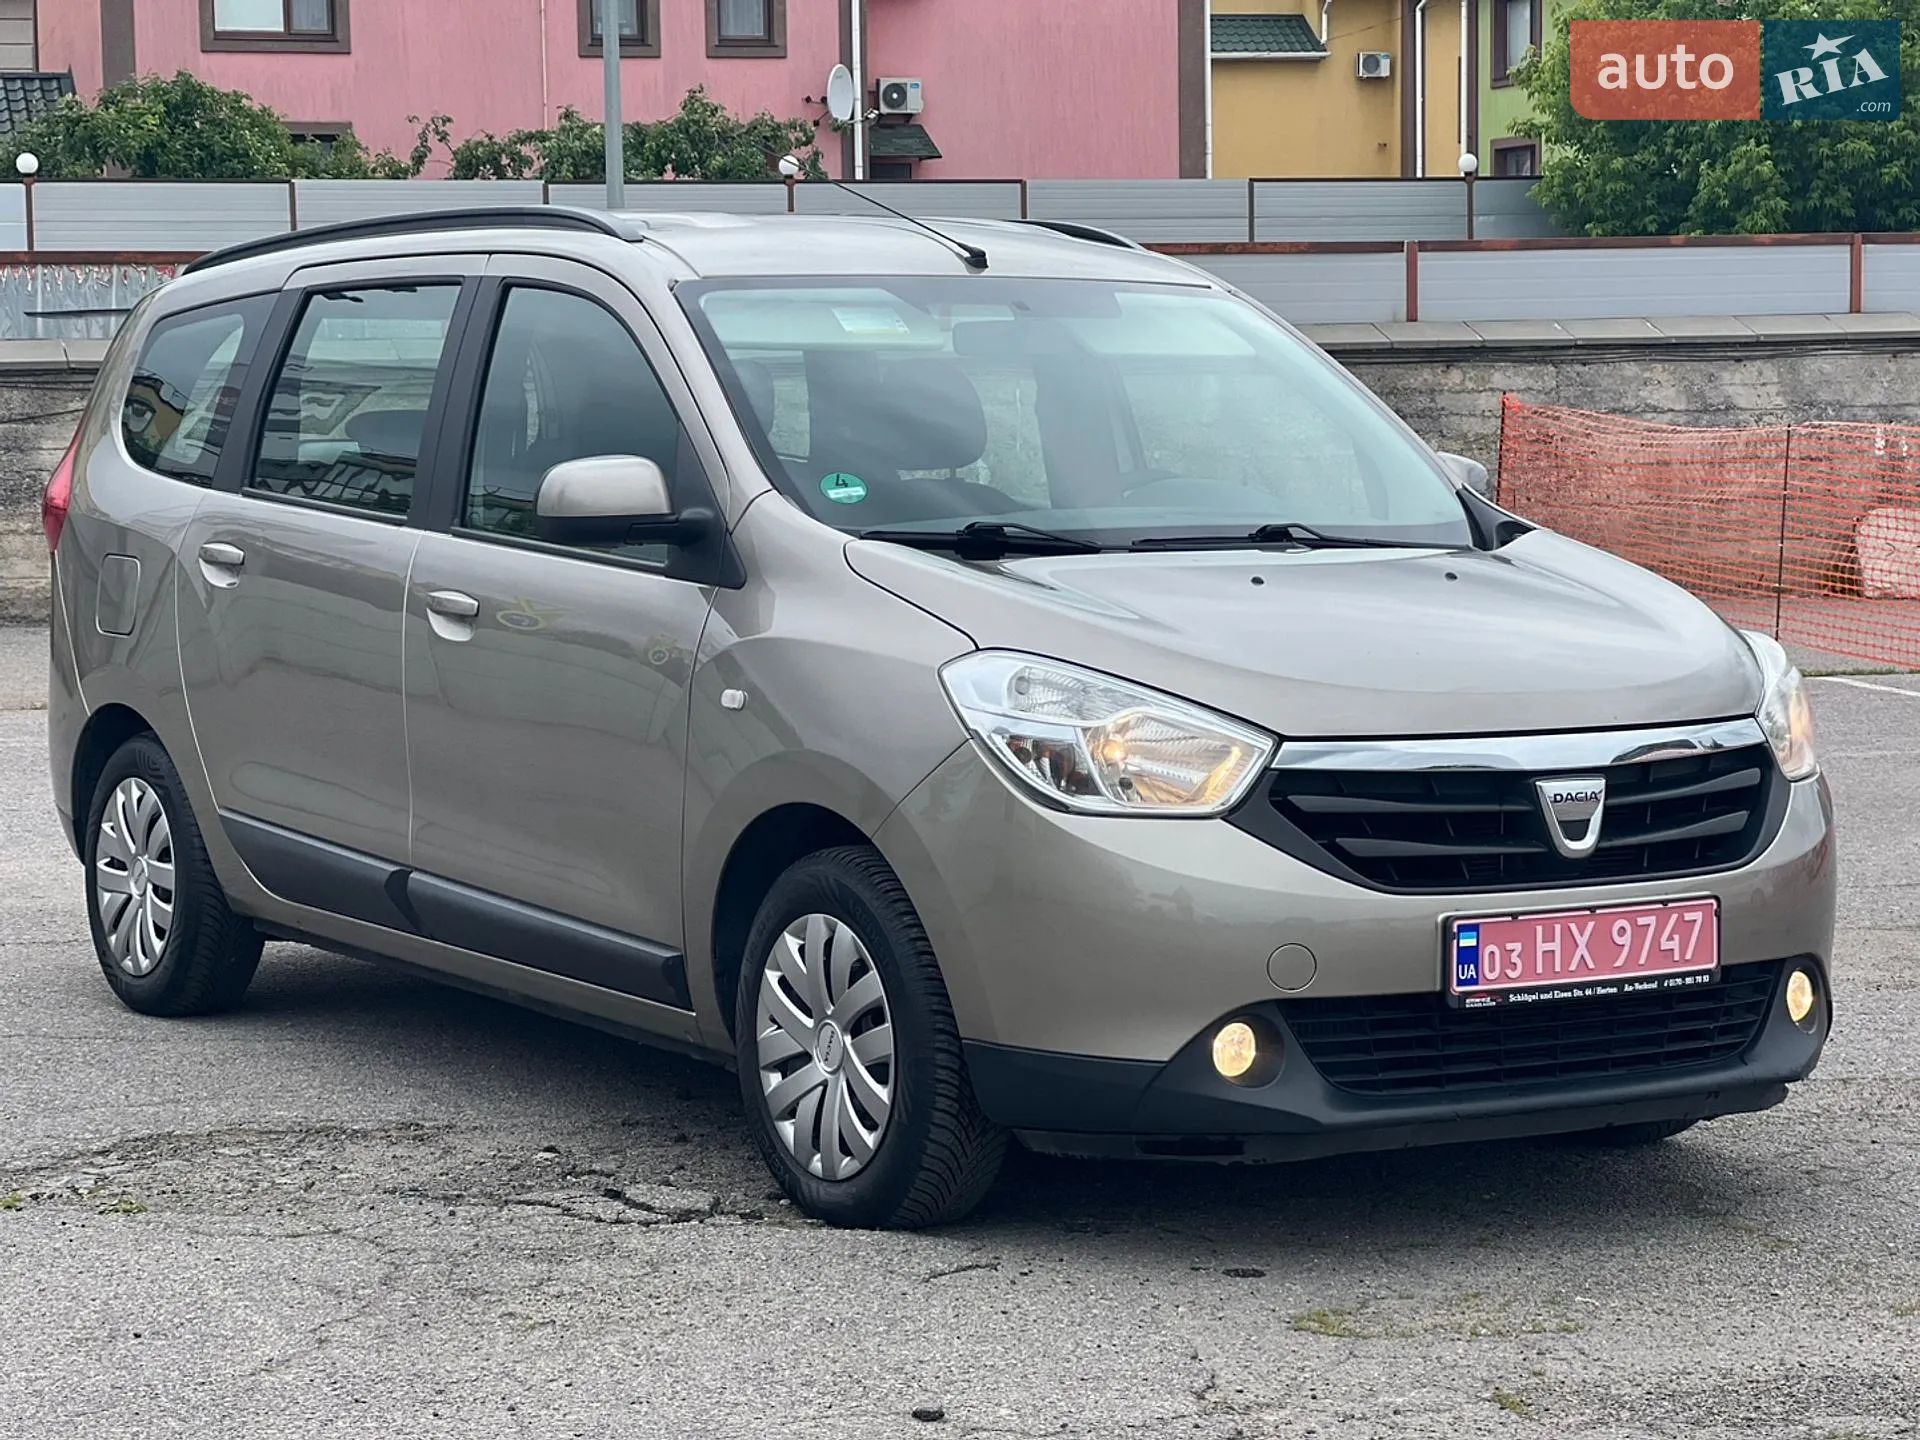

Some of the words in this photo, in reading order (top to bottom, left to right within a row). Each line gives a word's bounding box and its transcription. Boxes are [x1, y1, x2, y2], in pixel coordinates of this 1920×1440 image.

[835, 473, 848, 488] 4
[1553, 791, 1599, 803] DACIA
[1482, 942, 1523, 980] 03
[1535, 921, 1595, 975] HX
[1611, 911, 1703, 968] 9747
[1458, 963, 1477, 980] UA
[1540, 991, 1553, 1000] und
